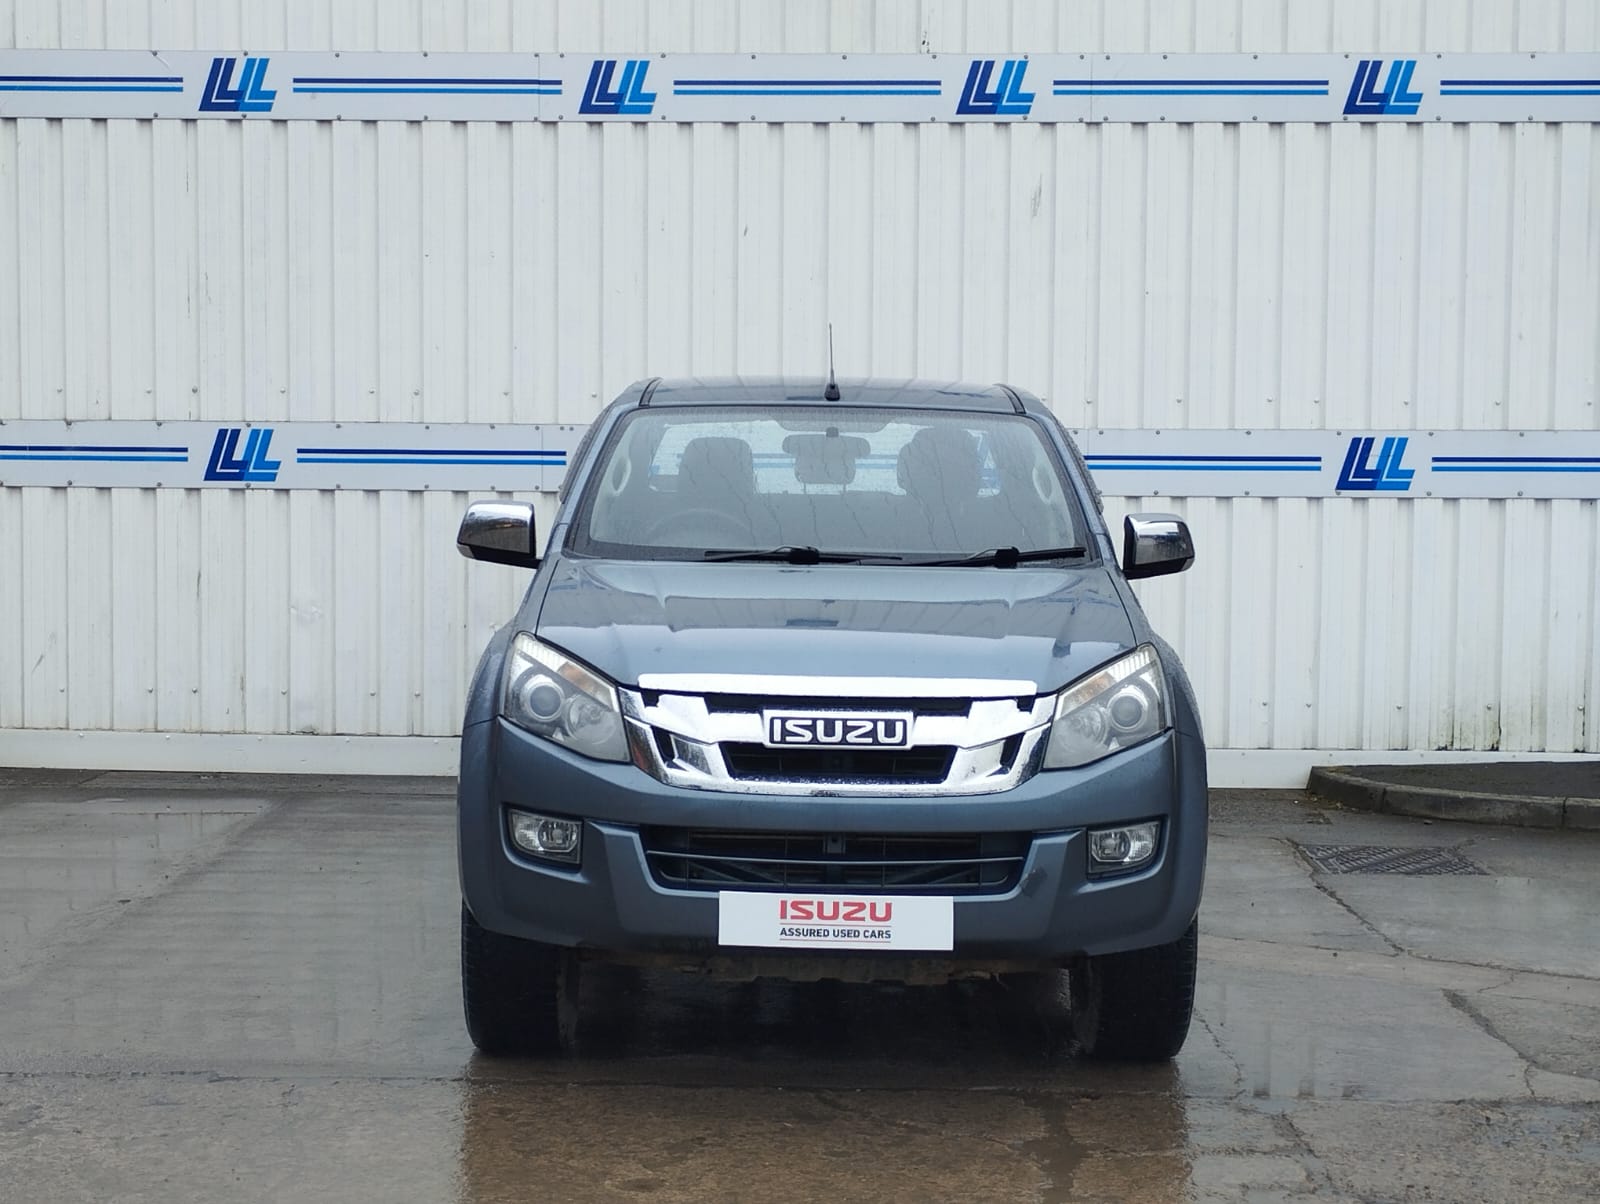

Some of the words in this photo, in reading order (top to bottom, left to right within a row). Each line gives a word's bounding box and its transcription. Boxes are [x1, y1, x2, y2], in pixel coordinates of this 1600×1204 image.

[773, 718, 904, 744] ISUZU
[780, 899, 893, 922] ISUZU
[780, 927, 830, 938] ASSURED
[832, 929, 861, 938] USED
[863, 930, 891, 939] CARS
